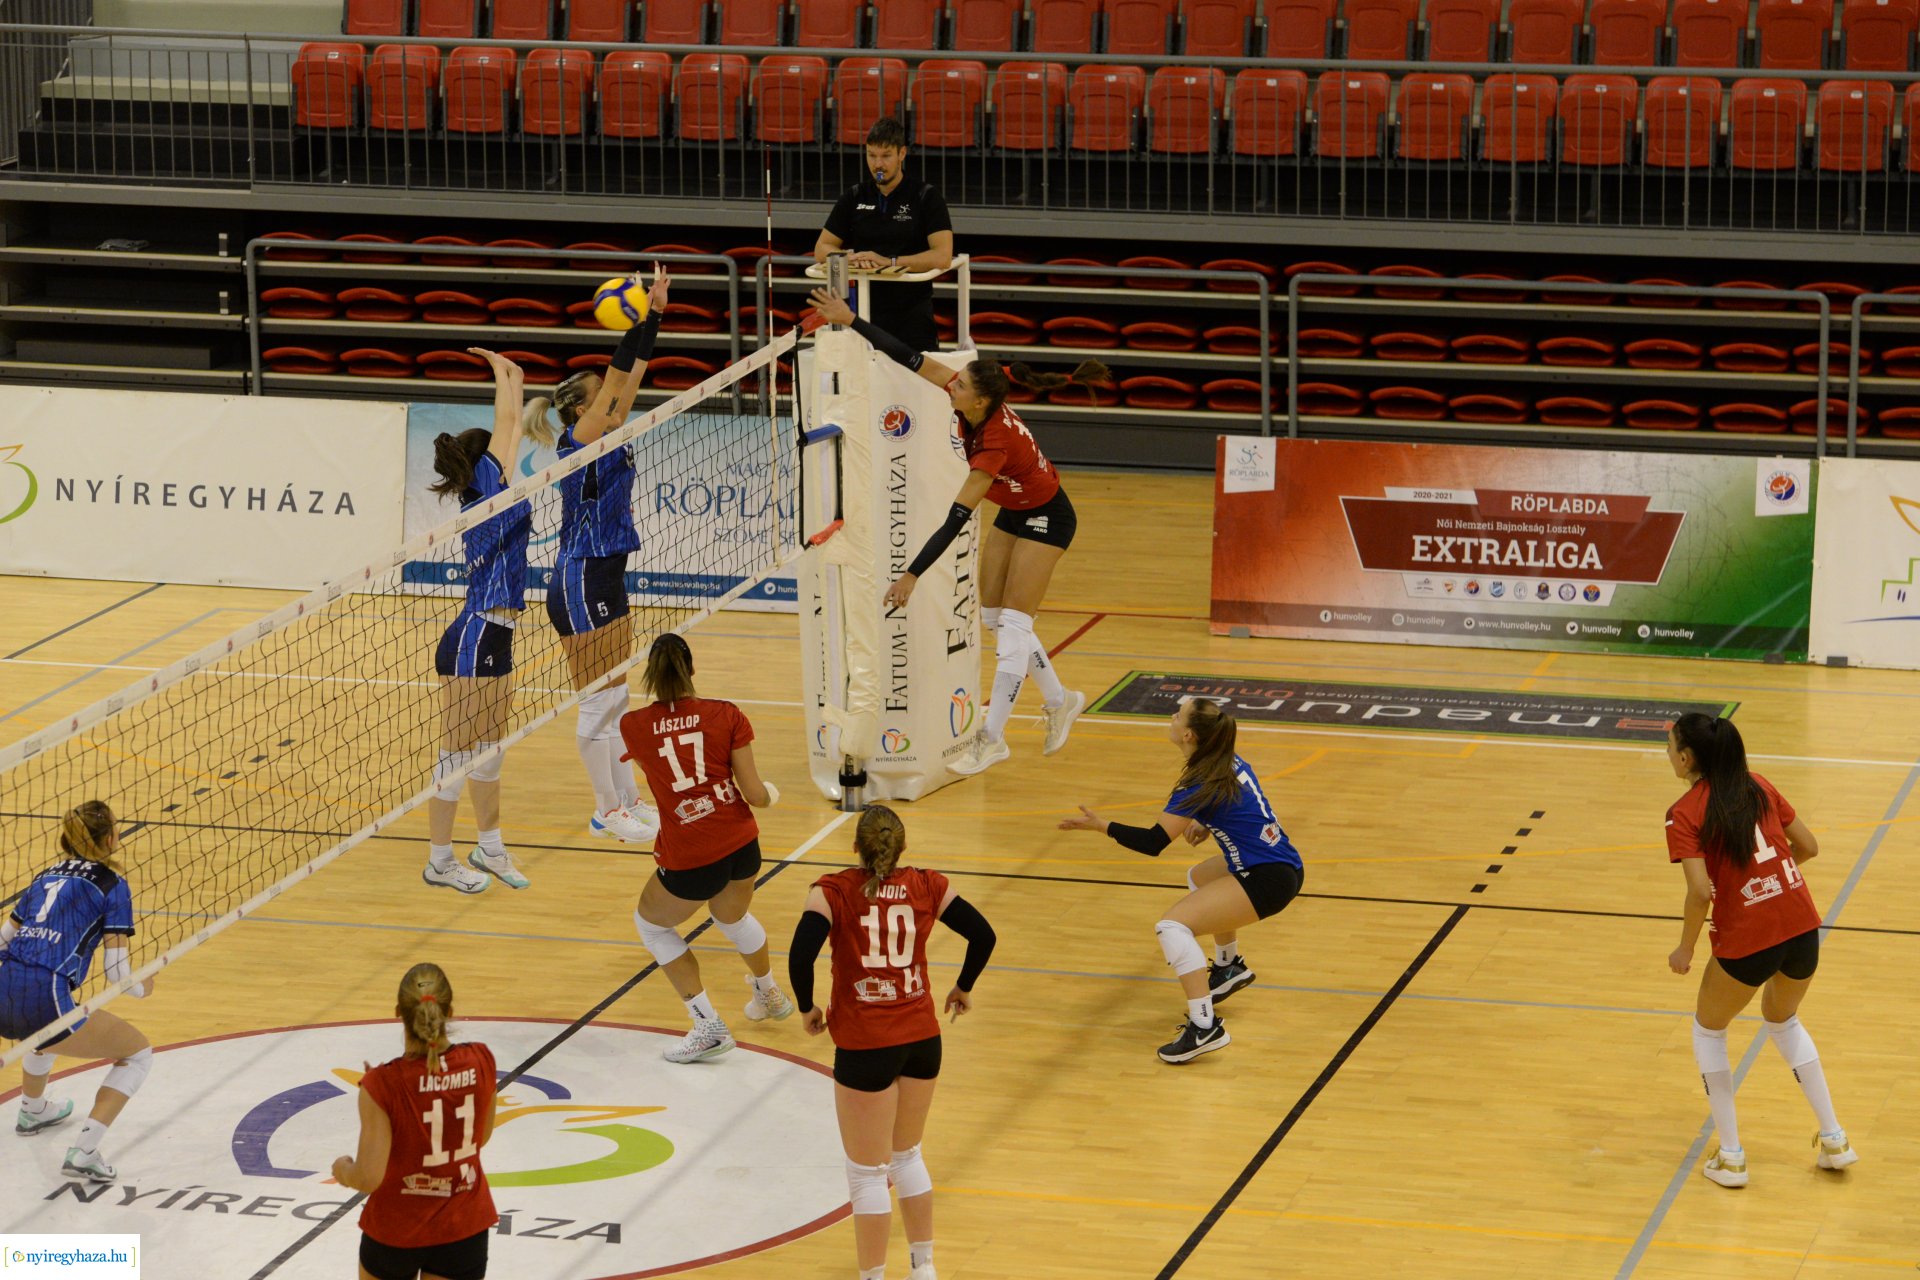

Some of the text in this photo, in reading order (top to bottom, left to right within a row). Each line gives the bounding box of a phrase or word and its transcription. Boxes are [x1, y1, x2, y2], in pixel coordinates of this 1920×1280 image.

[55, 474, 356, 516] NYÍREGYHÁZA
[655, 477, 795, 519] RÖPLA
[1413, 491, 1452, 500] 2020-2021
[1511, 493, 1609, 515] RÖPLABDA
[1436, 518, 1453, 530] Női
[1455, 519, 1494, 531] Nemzeti
[1496, 522, 1545, 535] Bajnokság
[1411, 534, 1603, 571] EXTRALIGA
[885, 452, 909, 714] FATUM-NÍREGYHÁZA
[597, 602, 608, 617] 5
[1333, 612, 1372, 624] hunvolley
[1406, 615, 1446, 627] hunvolley
[1478, 619, 1551, 632] www.hunvolley.hu
[1582, 624, 1622, 637] hunvolley
[1655, 627, 1695, 640] hunvolley
[1160, 684, 1295, 699] Online
[653, 714, 700, 735] LÁSZLOP
[941, 734, 979, 759] NYÍREGYHÁ
[657, 731, 709, 793] 17
[34, 870, 97, 881] UDAPEST
[43, 878, 69, 923] 1
[864, 884, 908, 900] JDIC
[860, 904, 917, 969] 10
[419, 1068, 477, 1093] LACOMBE
[422, 1093, 477, 1167] 11
[43, 1180, 622, 1244] NYÍREGÁZA
